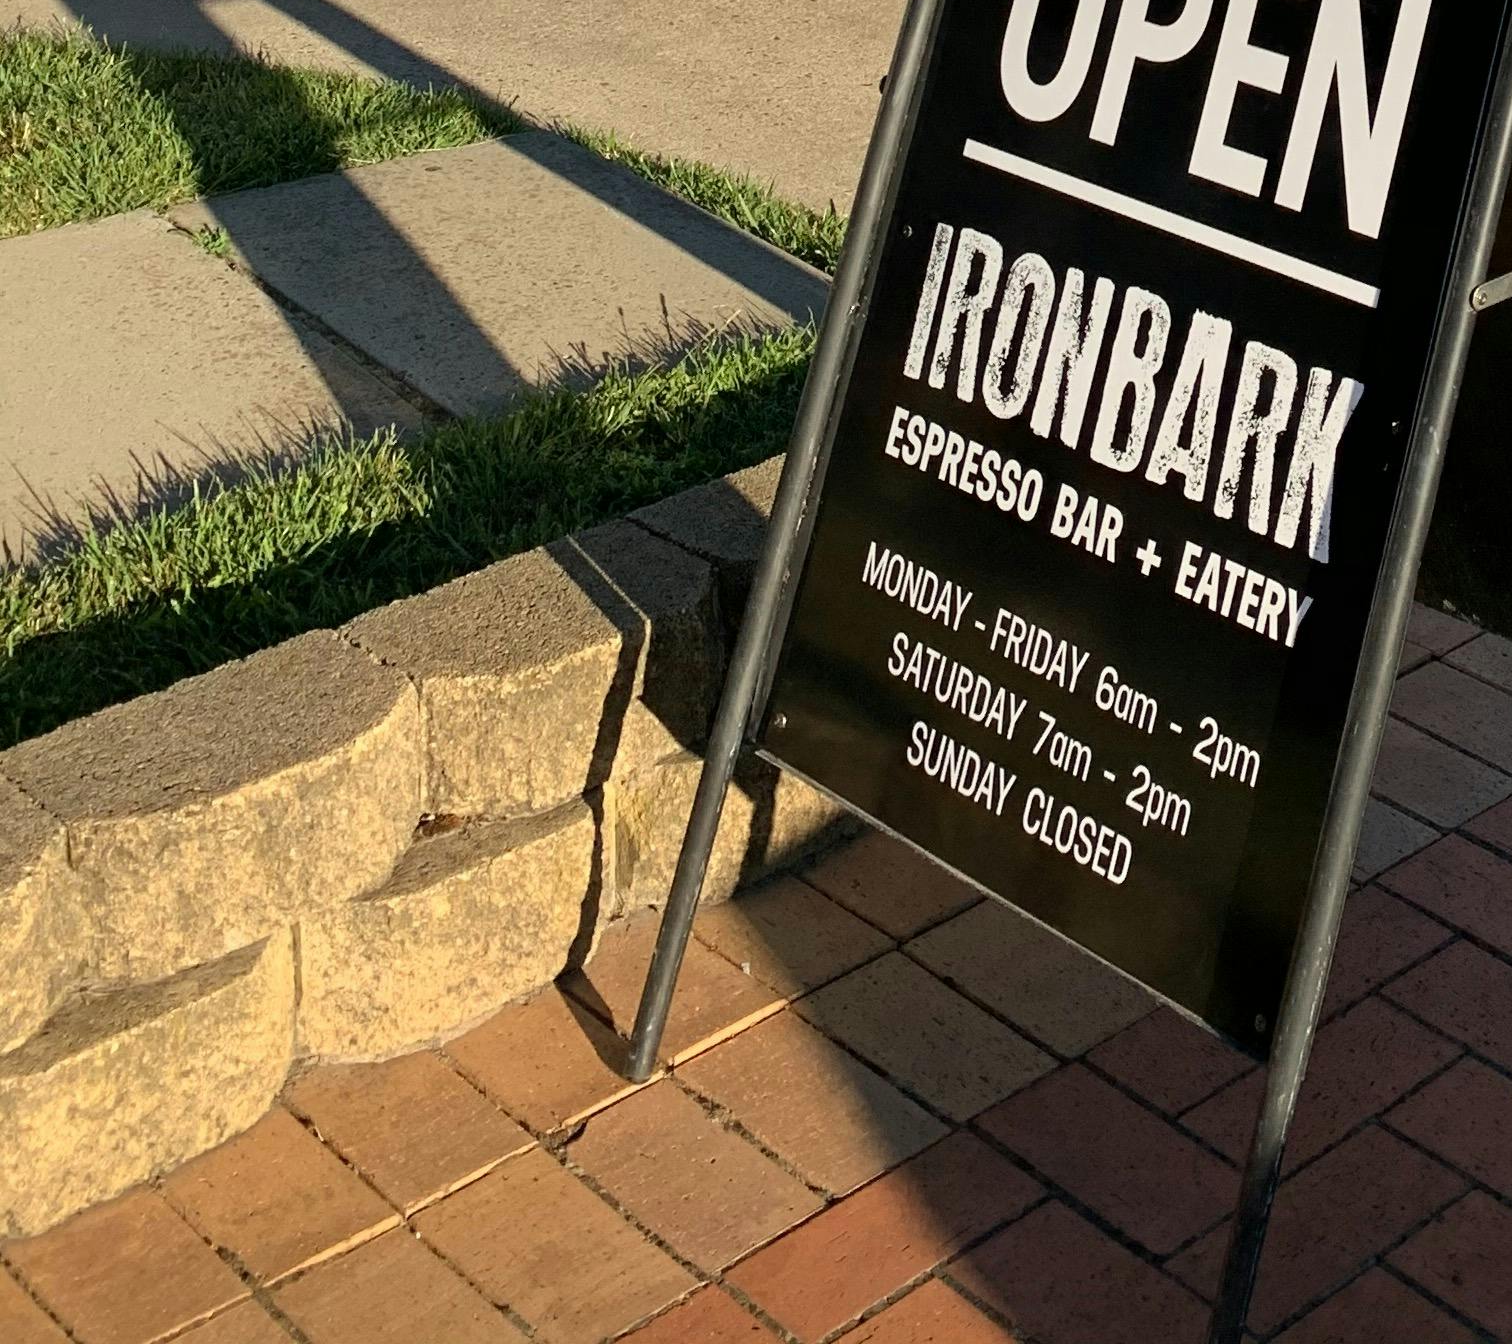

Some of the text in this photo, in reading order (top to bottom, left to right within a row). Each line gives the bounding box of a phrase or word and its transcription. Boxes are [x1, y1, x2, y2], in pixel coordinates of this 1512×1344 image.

[903, 222, 1365, 564] IRONBARK
[884, 405, 1314, 648] ESPRESSO BAR + EATERY
[861, 541, 1261, 788] MONDAY - FRIDAY 6am - 2pm
[887, 632, 1192, 836] SATURDAY 7am - 2pm
[906, 721, 1133, 885] SUNDAY CLOSED
